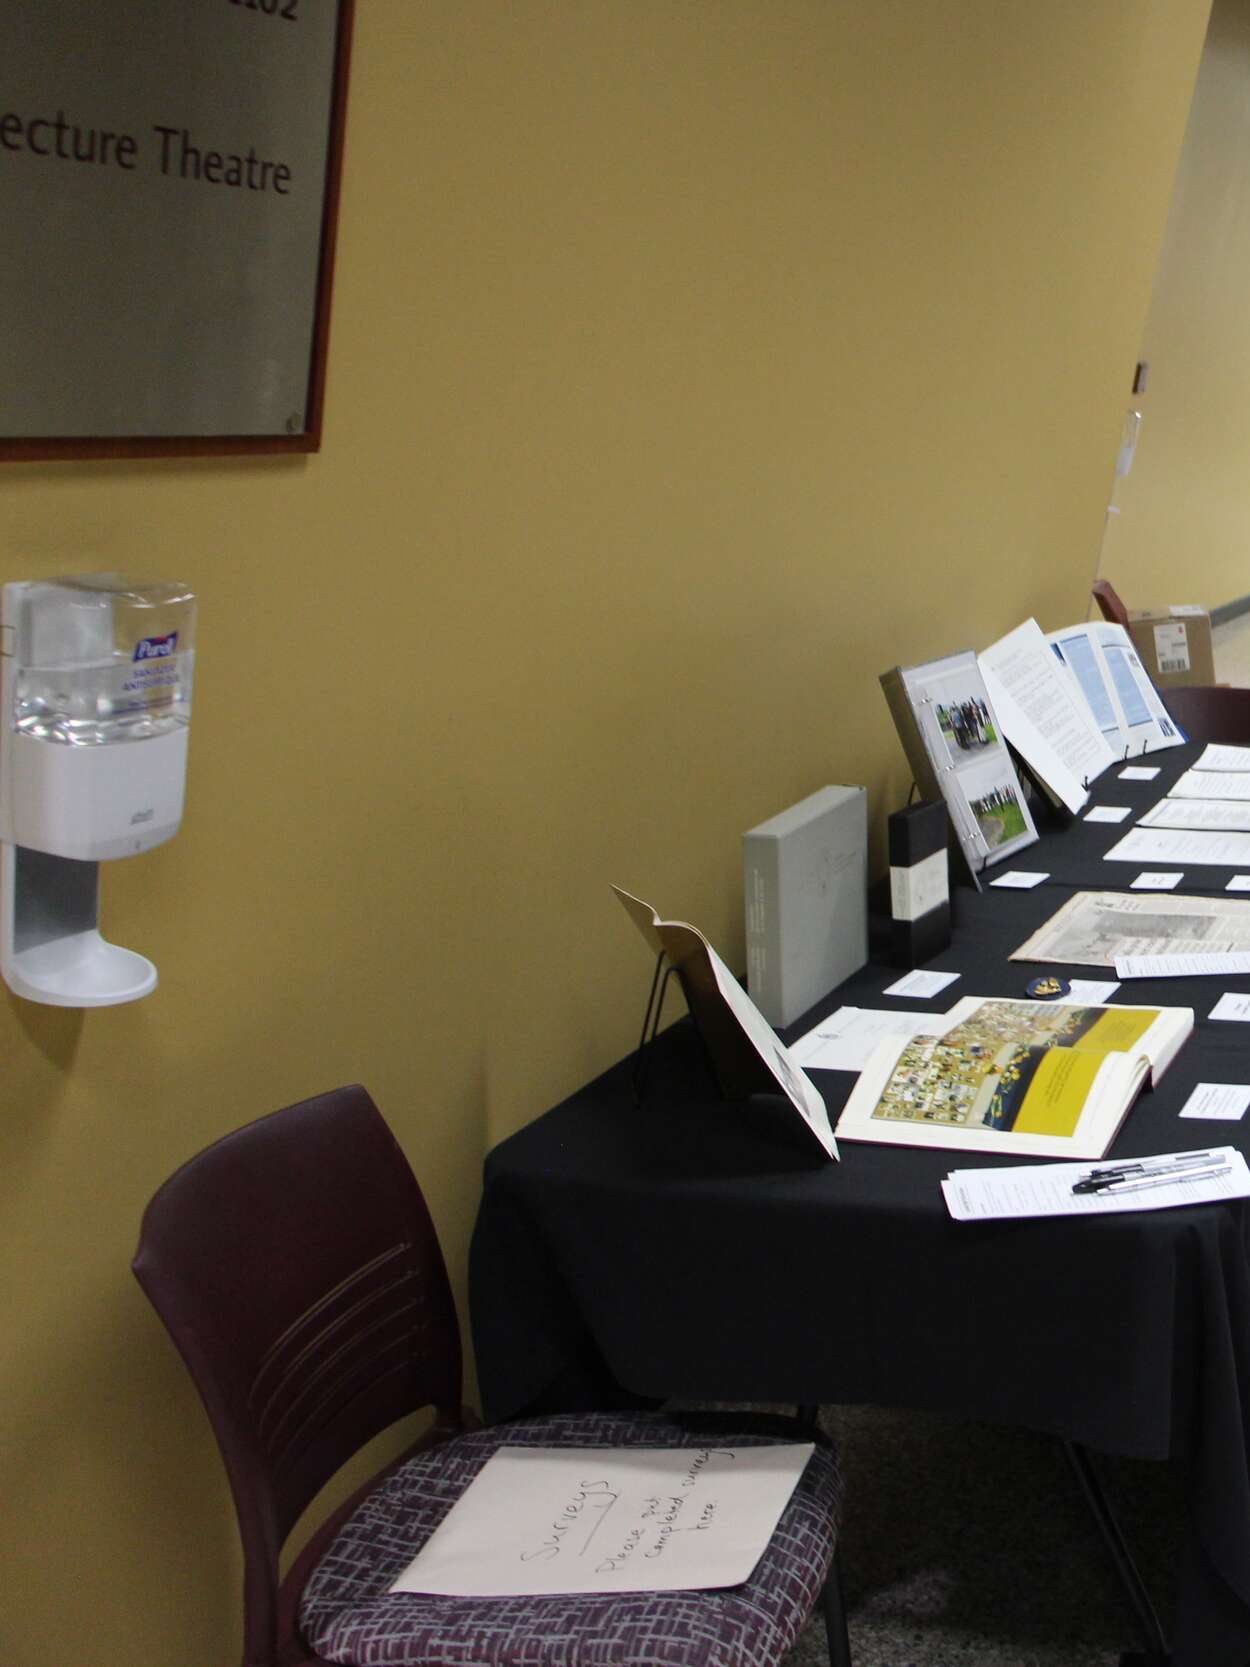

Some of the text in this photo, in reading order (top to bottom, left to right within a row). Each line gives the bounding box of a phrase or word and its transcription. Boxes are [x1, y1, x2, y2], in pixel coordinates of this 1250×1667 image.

[153, 125, 292, 194] Theatre
[520, 1480, 618, 1561] Surveys
[595, 1529, 645, 1573] Please
